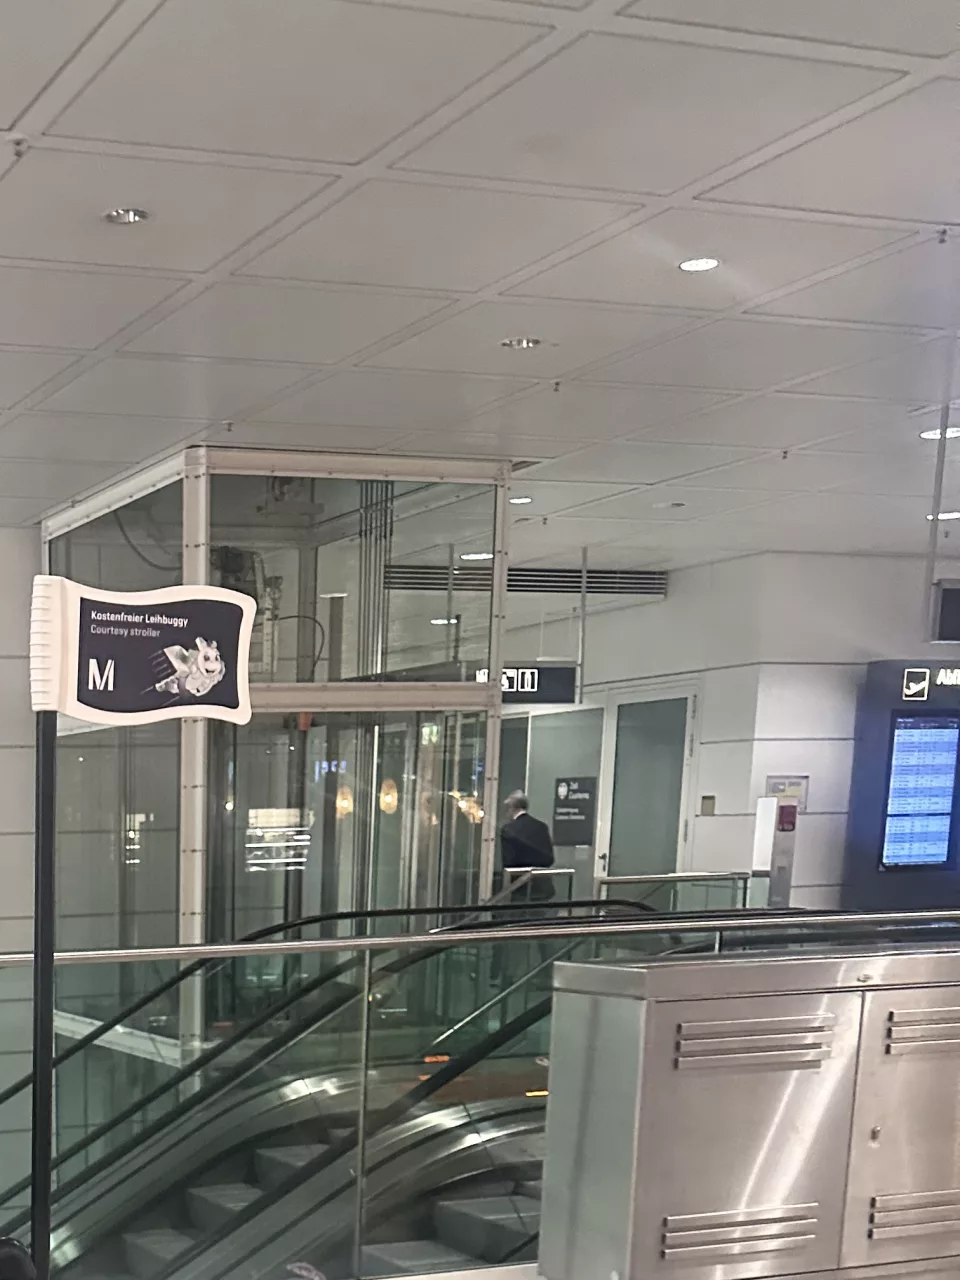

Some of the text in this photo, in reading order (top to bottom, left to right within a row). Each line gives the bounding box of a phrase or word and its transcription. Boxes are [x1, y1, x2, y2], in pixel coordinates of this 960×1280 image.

[91, 610, 189, 627] Kostenfreier Leihbuggy
[90, 624, 161, 637] Courtesy stroller
[88, 658, 115, 691] M
